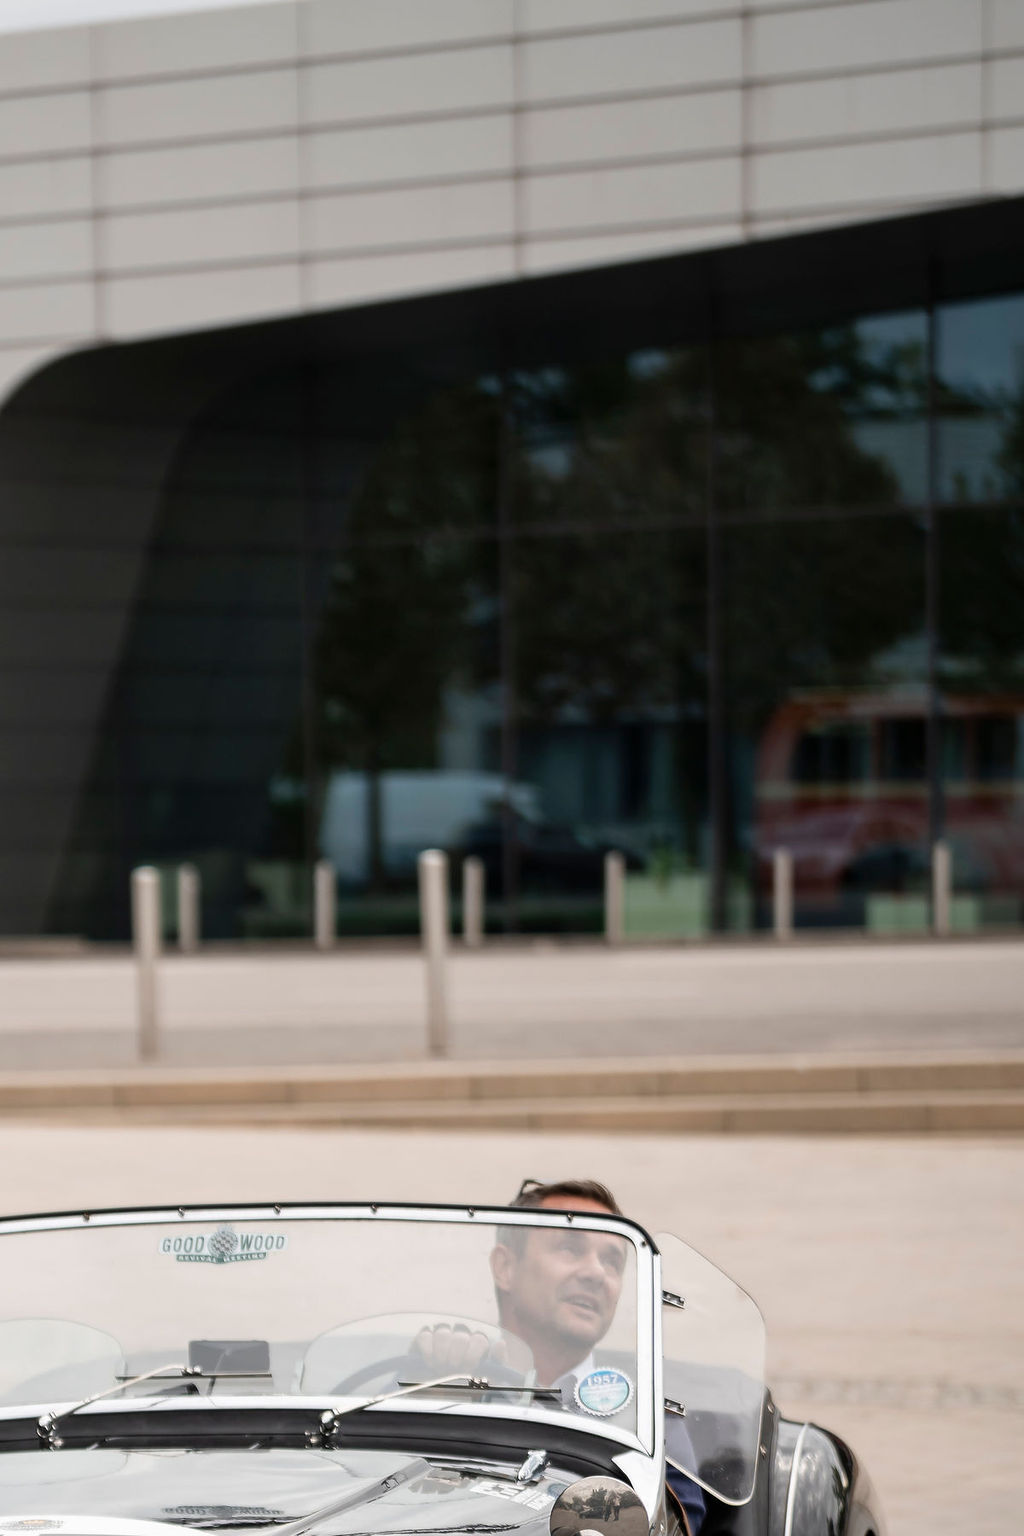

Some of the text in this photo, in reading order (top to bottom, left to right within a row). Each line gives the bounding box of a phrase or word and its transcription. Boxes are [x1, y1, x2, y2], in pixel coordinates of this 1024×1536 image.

[161, 1233, 285, 1253] GOOD WOOD
[587, 1374, 618, 1386] 1957
